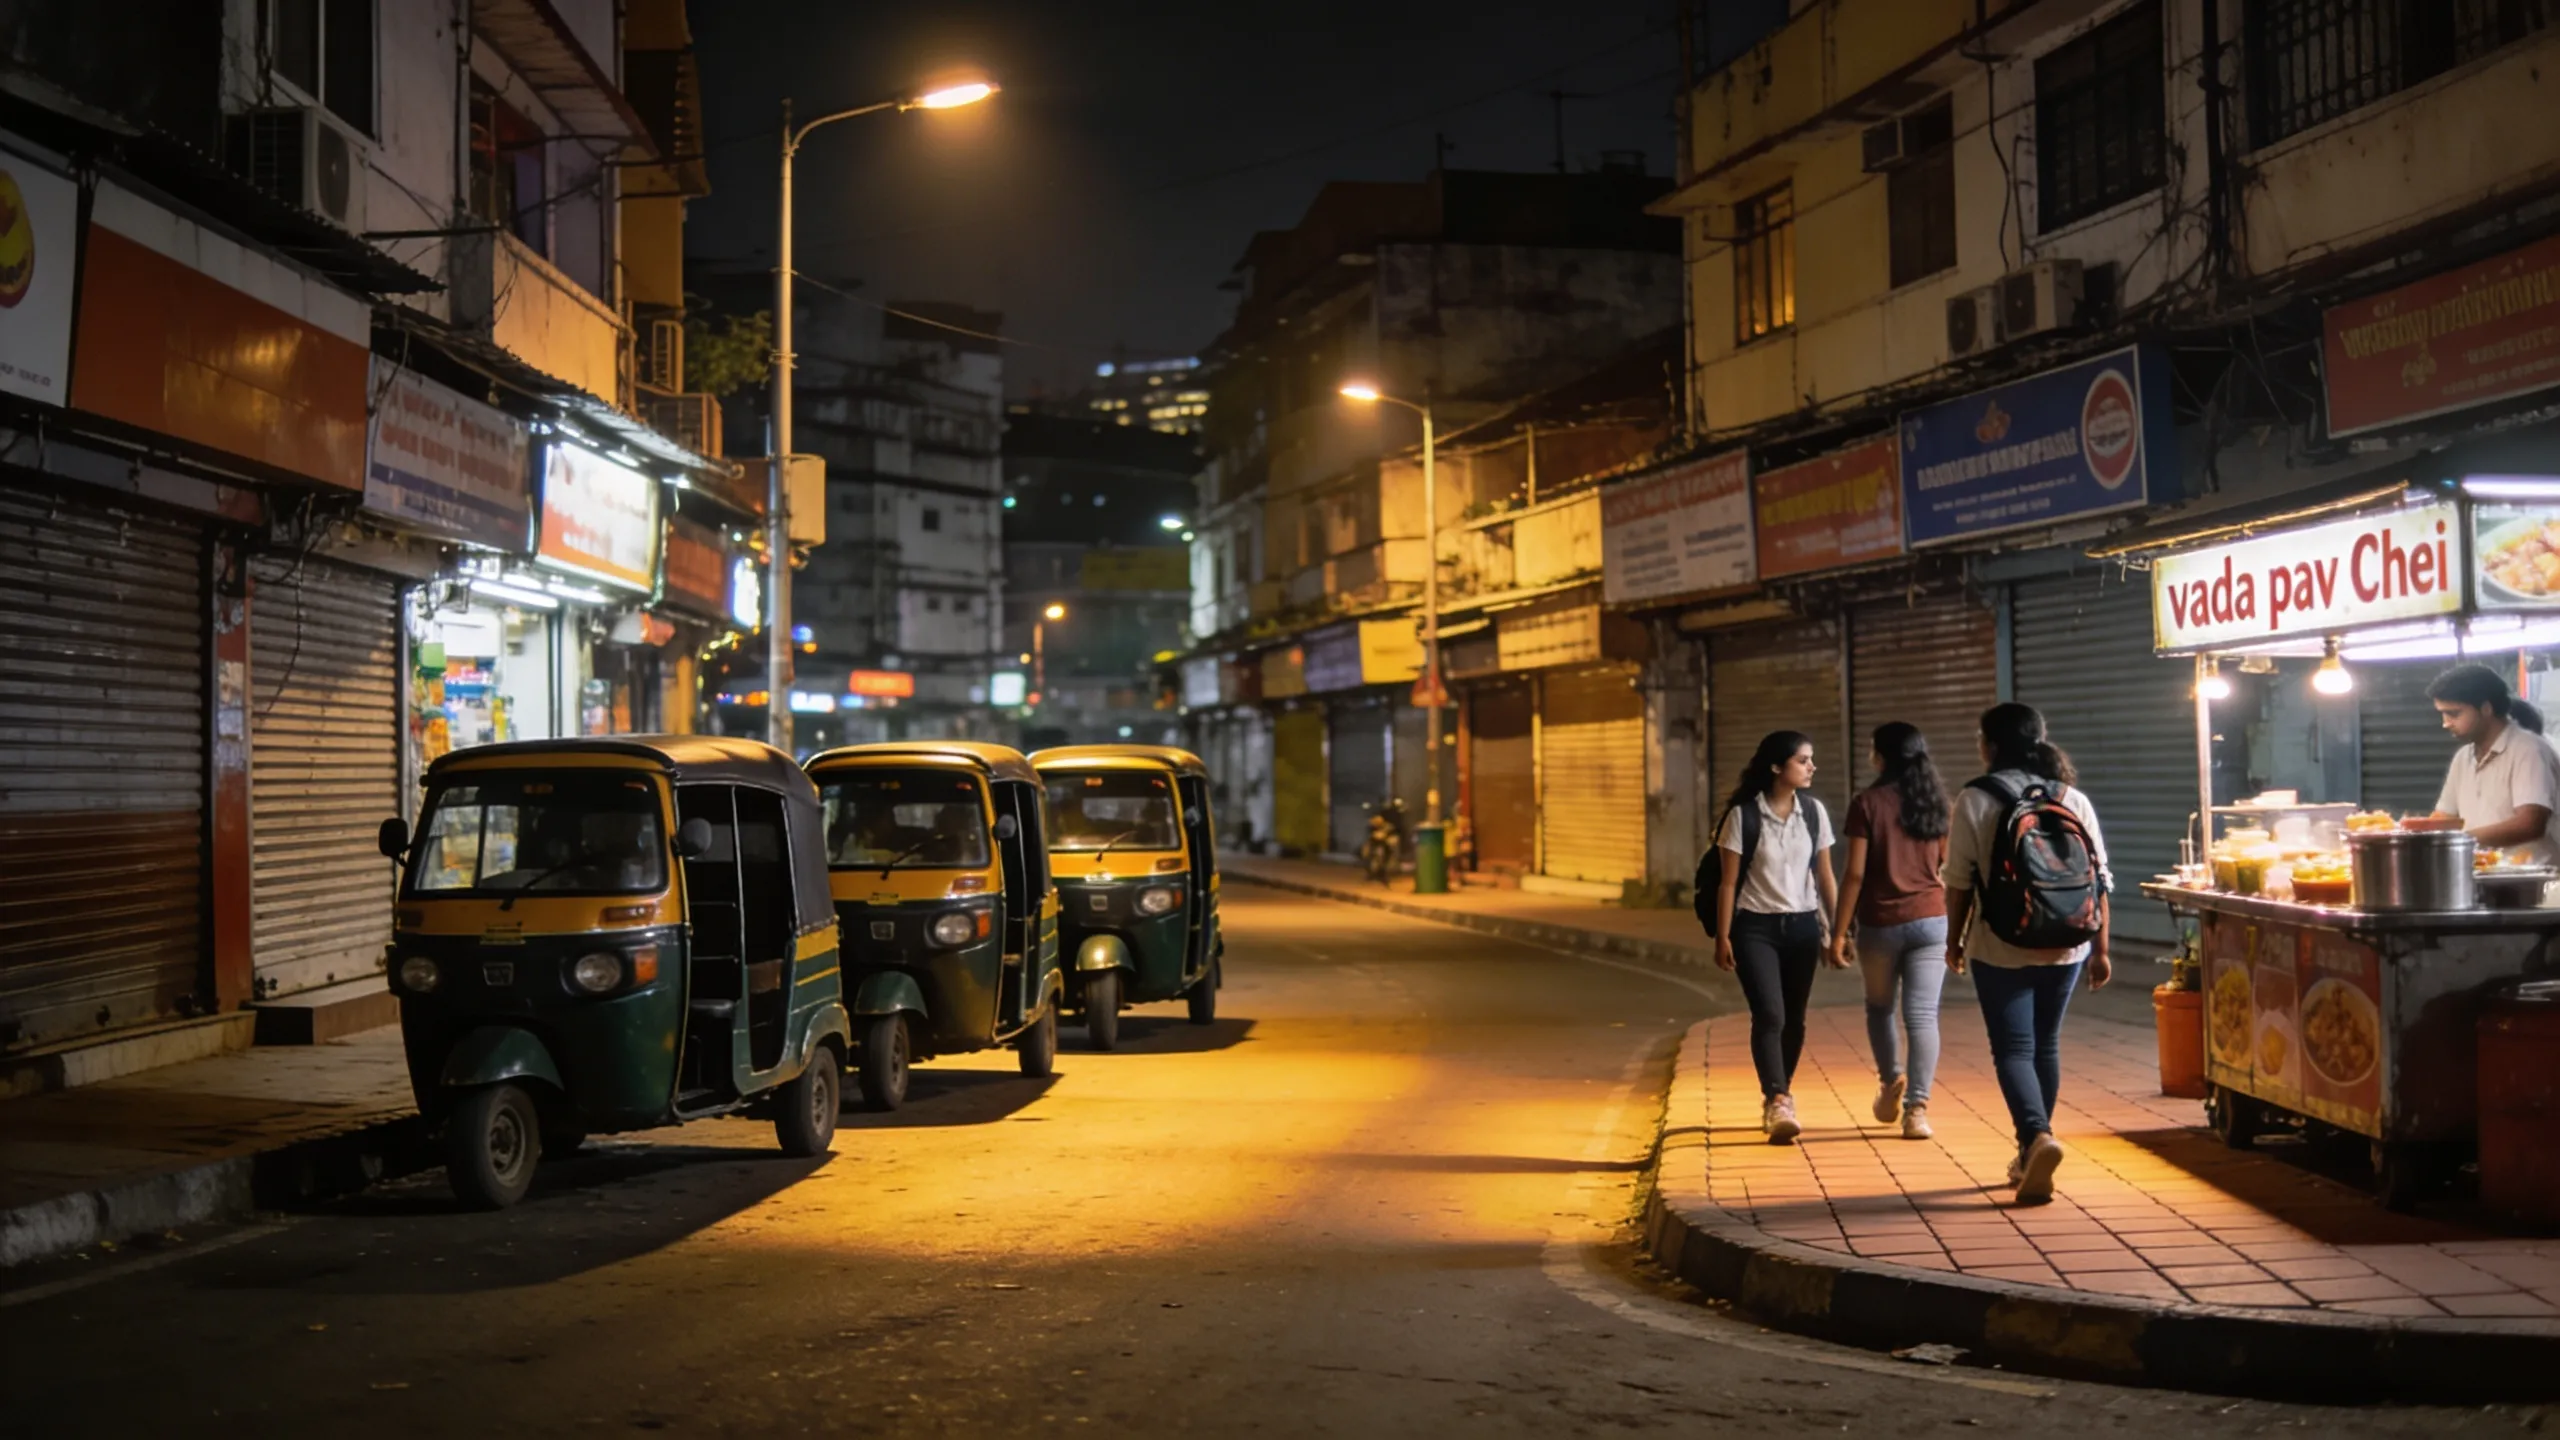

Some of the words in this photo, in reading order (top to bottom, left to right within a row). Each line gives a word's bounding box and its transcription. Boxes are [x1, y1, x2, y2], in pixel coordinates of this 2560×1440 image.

[2168, 555, 2256, 630] vada
[2269, 556, 2339, 631] pav
[2351, 519, 2449, 604] Chei
